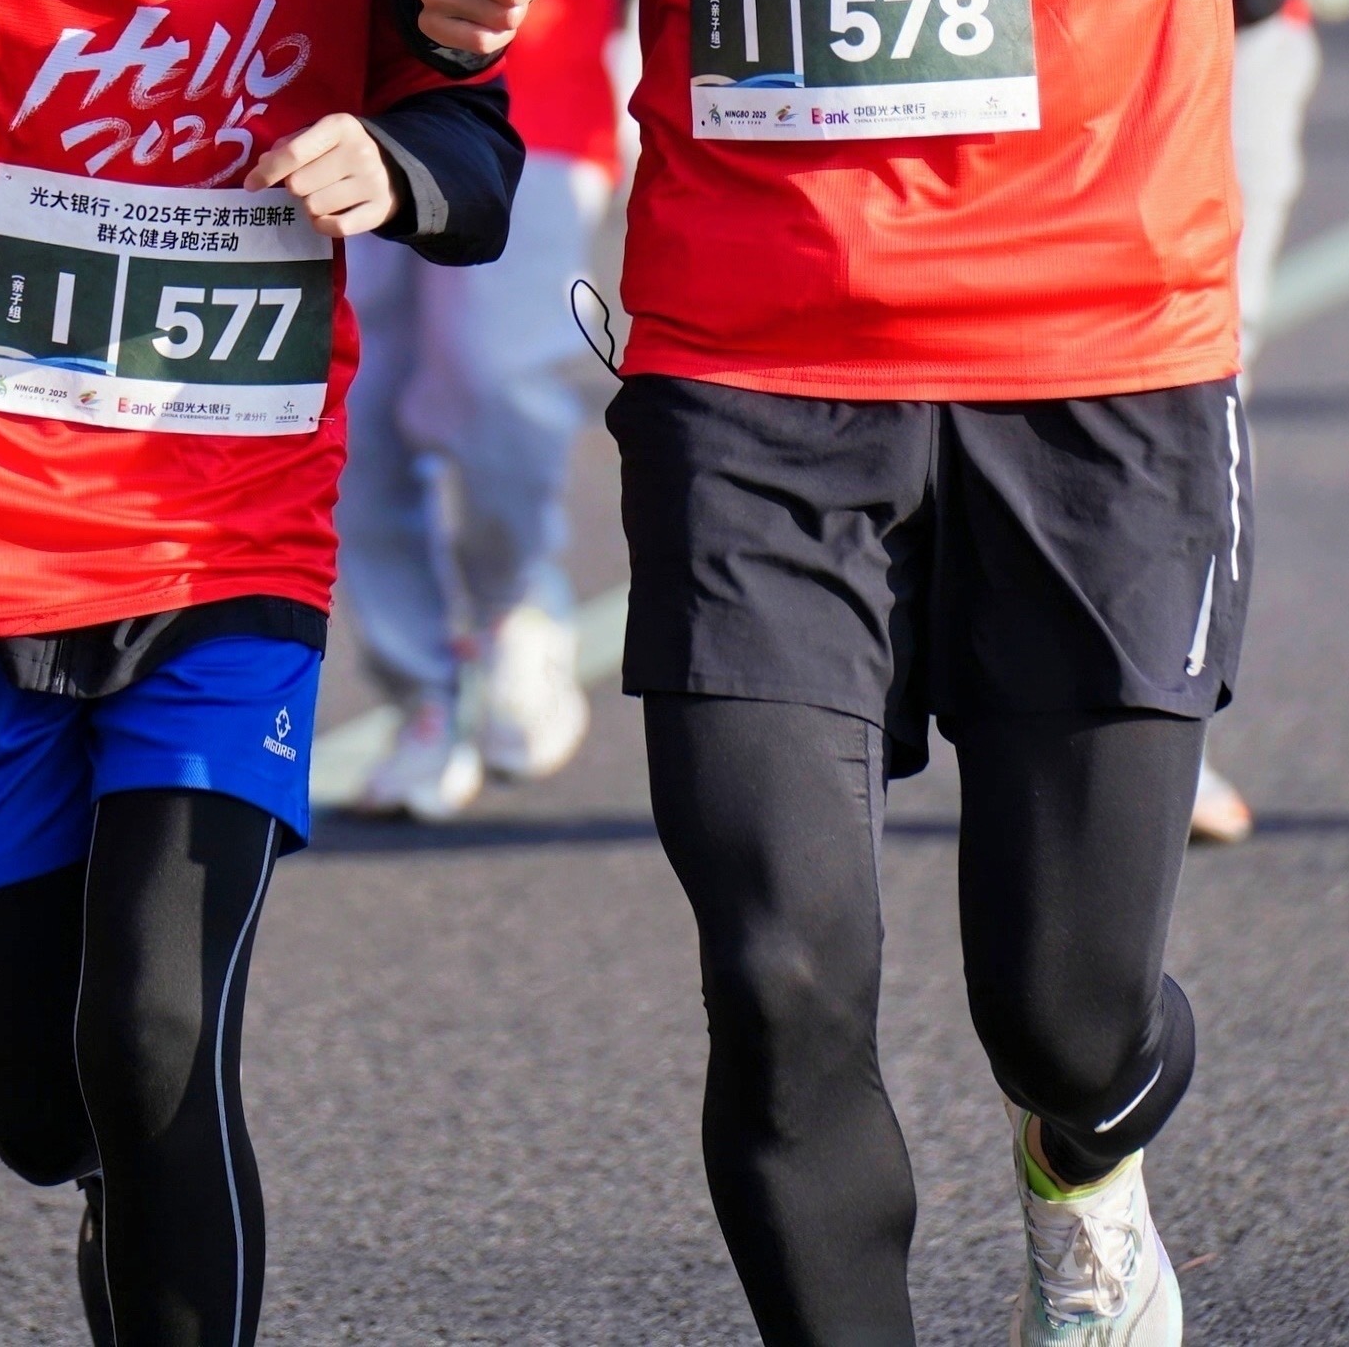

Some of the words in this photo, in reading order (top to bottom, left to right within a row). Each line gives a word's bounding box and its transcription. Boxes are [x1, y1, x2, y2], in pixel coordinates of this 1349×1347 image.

[724, 110, 750, 119] NINGBO
[752, 110, 767, 119] 2025
[853, 103, 926, 117] 中国光大银行
[60, 96, 268, 188] 2025
[97, 223, 239, 252] 群众健身跑活动
[151, 285, 302, 361] 577
[13, 383, 45, 395] NINGBO
[49, 389, 68, 399] 2025
[162, 402, 231, 415] 中国光大银行
[235, 412, 267, 421] 宁波分行
[262, 735, 297, 762] RIGORER
